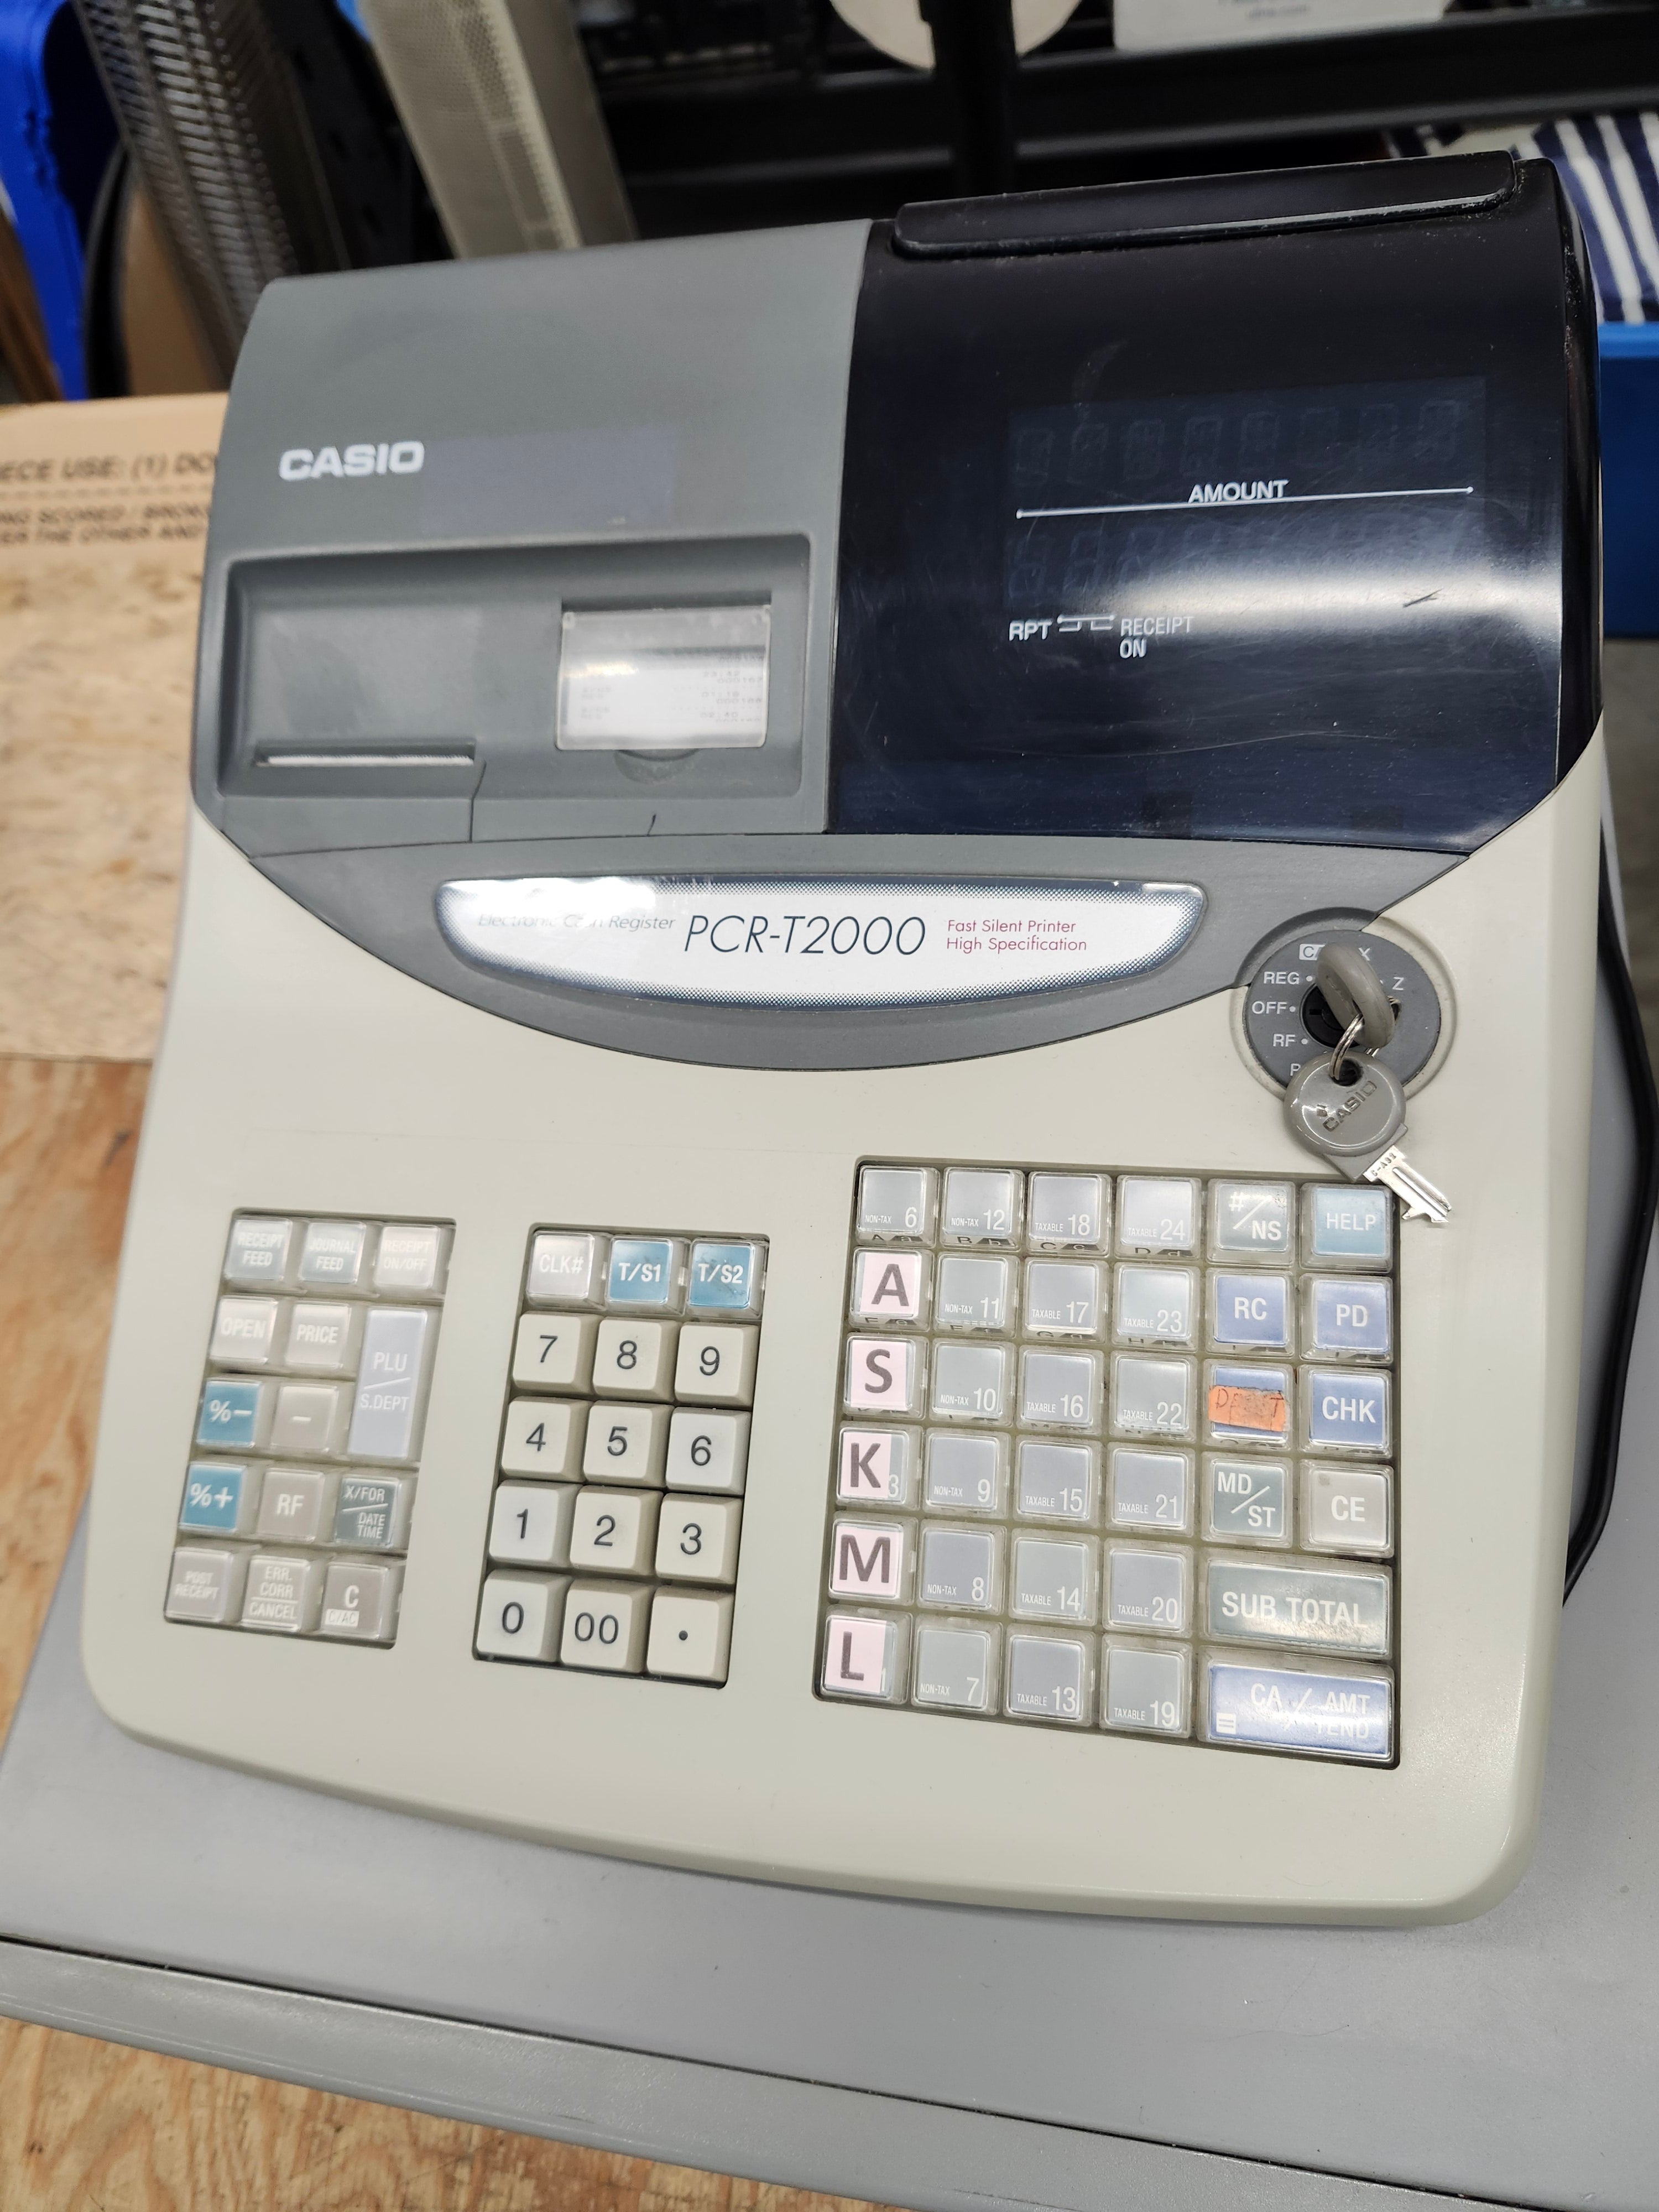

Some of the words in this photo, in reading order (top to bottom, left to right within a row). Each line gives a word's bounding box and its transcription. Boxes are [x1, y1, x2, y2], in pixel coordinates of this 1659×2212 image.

[279, 441, 424, 481] CASIO
[1188, 479, 1289, 504] AMOUNT
[1009, 620, 1052, 641] RPT
[1120, 617, 1194, 637] RECEIPT
[1120, 638, 1147, 659] ON
[608, 915, 676, 932] Register
[685, 915, 926, 955] PCR-T2000
[948, 920, 978, 933] Fast
[982, 919, 1022, 933] Silent
[1028, 920, 1076, 933] Printer
[947, 937, 982, 954] High
[988, 936, 1087, 952] Specification
[1264, 972, 1299, 984] REG
[1392, 977, 1404, 990] Z
[1252, 1001, 1287, 1014] OFF
[1273, 1035, 1295, 1047] RF
[1323, 1081, 1377, 1131] CASIO
[865, 1214, 892, 1225] NON-TAX
[905, 1206, 917, 1228] 6
[951, 1217, 979, 1228] NON-TAX
[983, 1209, 1005, 1231] 12
[1035, 1222, 1063, 1233] TAXABLE
[1068, 1213, 1091, 1236] 18
[1326, 1213, 1376, 1231] HELP
[237, 1232, 284, 1248] RECEIPT
[1128, 1227, 1157, 1238] TAXABLE
[1160, 1218, 1186, 1241] 24
[309, 1238, 356, 1254] JOURNAL
[383, 1239, 431, 1253] RECEIPT
[243, 1251, 273, 1266] FEED
[316, 1256, 343, 1272] FEED
[384, 1258, 427, 1271] ON/OFF
[540, 1255, 583, 1275] CLK#
[619, 1262, 661, 1282] T/S1
[698, 1263, 743, 1284] T/S2
[871, 1264, 909, 1307] A
[945, 1303, 973, 1314] NON-TAX
[980, 1297, 1000, 1319] 11
[1032, 1309, 1061, 1319] TAXABLE
[1066, 1301, 1089, 1324] 17
[1234, 1297, 1267, 1321] RC
[1335, 1304, 1368, 1327] PD
[221, 1318, 267, 1338] OPEN
[1124, 1317, 1154, 1328] TAXABLE
[1157, 1310, 1182, 1333] 23
[297, 1324, 338, 1343] PRICE
[540, 1335, 558, 1363] 7
[617, 1340, 637, 1370] 8
[373, 1352, 408, 1372] PLU
[699, 1346, 719, 1376] 9
[865, 1348, 893, 1394] S
[361, 1394, 409, 1412] S.DEPT
[940, 1394, 969, 1406] NON-TAX
[973, 1387, 996, 1411] 10
[1026, 1402, 1056, 1413] TAXABLE
[1060, 1395, 1084, 1418] 16
[1322, 1396, 1376, 1423] CHK
[1123, 1408, 1152, 1421] TAXABLE
[1156, 1402, 1182, 1426] 22
[525, 1422, 546, 1452] 4
[607, 1426, 628, 1456] 5
[690, 1435, 712, 1466] 6
[850, 1442, 881, 1488] K
[344, 1485, 385, 1501] X/FOR
[934, 1486, 963, 1498] NON-TAX
[977, 1479, 990, 1503] 9
[1025, 1496, 1055, 1507] TAXABLE
[1060, 1488, 1083, 1511] 15
[277, 1494, 304, 1516] RF
[1118, 1502, 1149, 1514] TAXABLE
[1155, 1494, 1178, 1519] 21
[1331, 1495, 1365, 1522] CE
[358, 1512, 386, 1526] DATE
[517, 1509, 529, 1539] 1
[357, 1525, 383, 1539] TIME
[594, 1515, 615, 1547] 2
[680, 1522, 702, 1555] 3
[838, 1533, 890, 1584] M
[185, 1571, 213, 1585] POST
[265, 1567, 293, 1581] ERR.
[175, 1583, 218, 1599] RECEIPT
[260, 1583, 293, 1598] CORR
[345, 1585, 359, 1608] C
[927, 1584, 957, 1596] NON-TAX
[972, 1577, 984, 1601] 8
[1021, 1593, 1051, 1606] TAXABLE
[1057, 1586, 1081, 1611] 14
[249, 1603, 298, 1619] CANCEL
[502, 1601, 524, 1634] 0
[1118, 1604, 1149, 1617] TAXABLE
[1151, 1596, 1178, 1623] 20
[1222, 1591, 1276, 1620] SUB
[1286, 1598, 1368, 1629] TOTAL
[575, 1612, 619, 1644] 00
[841, 1631, 864, 1681] L
[920, 1682, 950, 1696] NON-TAX
[966, 1677, 979, 1702] 7
[1016, 1693, 1047, 1706] TAXABLE
[1052, 1686, 1076, 1712] 13
[1250, 1682, 1282, 1710] CA
[1325, 1691, 1370, 1714] AMT
[1114, 1708, 1145, 1721] TAXABLE
[1150, 1701, 1175, 1728] 19
